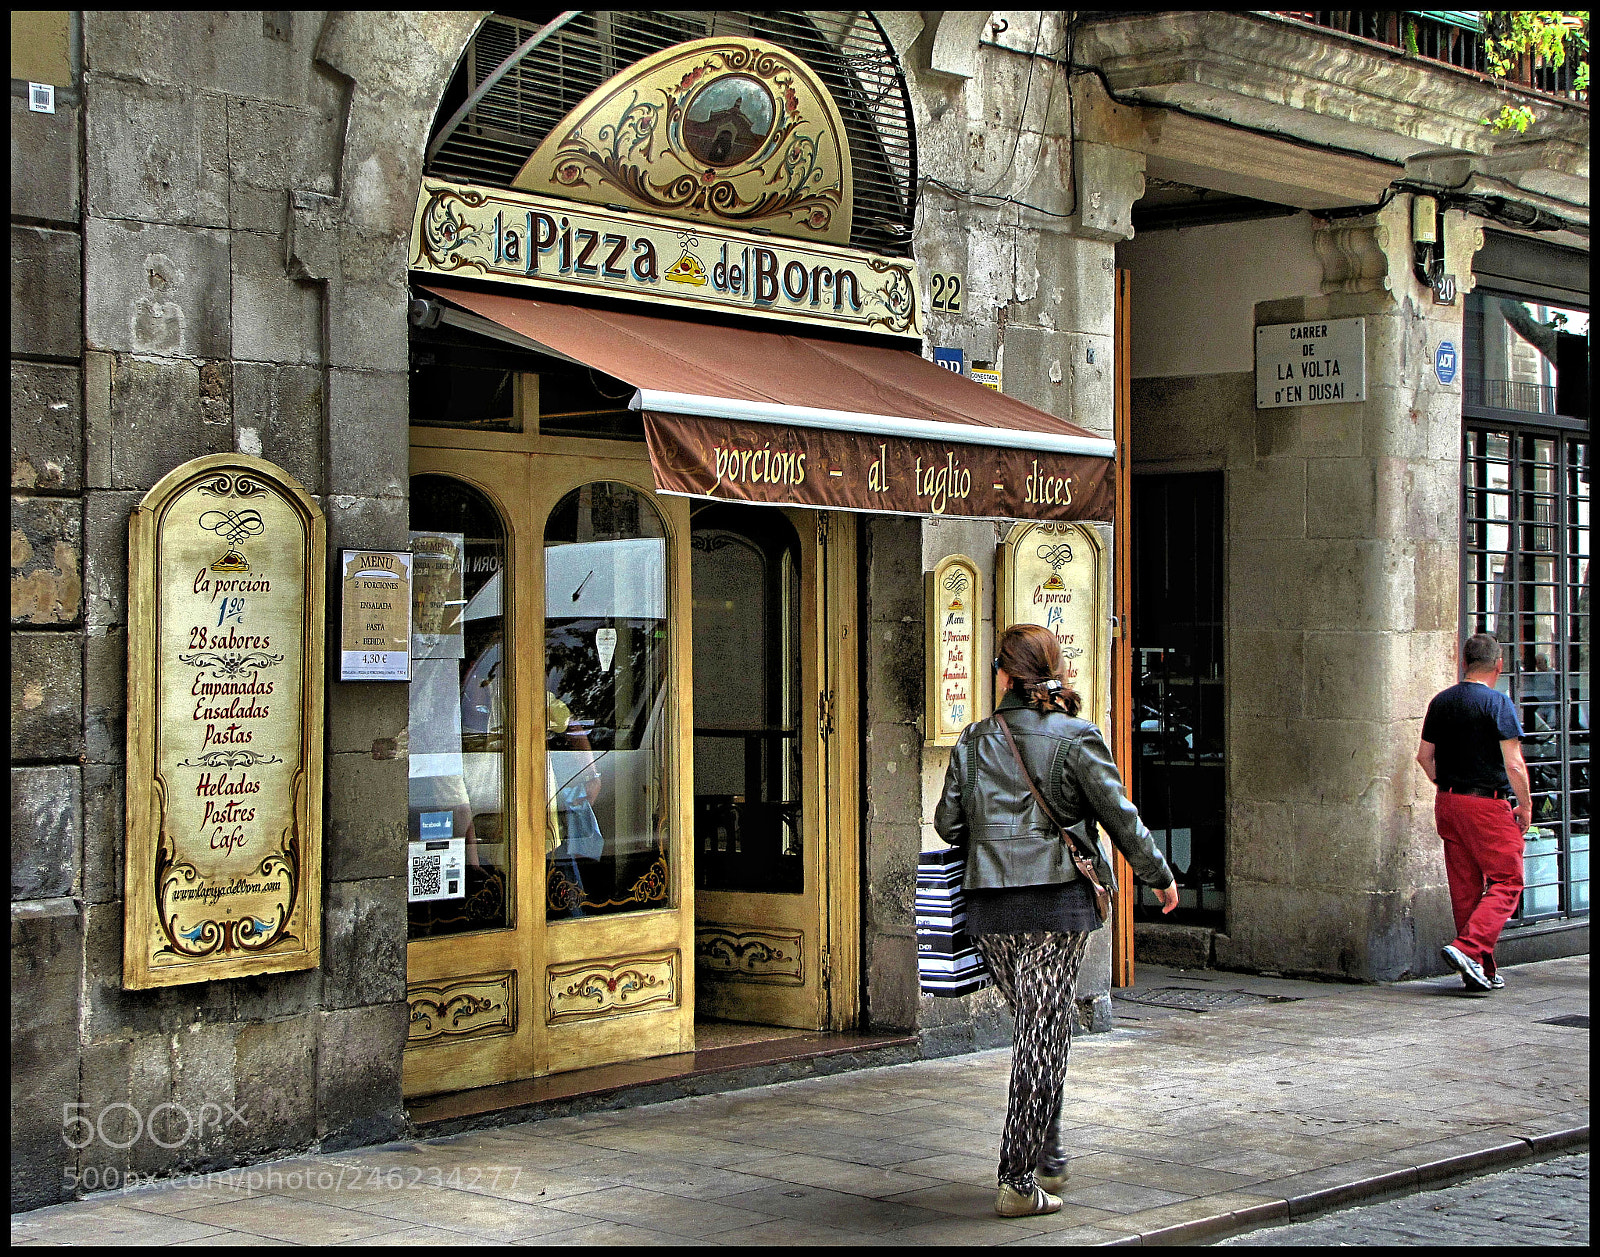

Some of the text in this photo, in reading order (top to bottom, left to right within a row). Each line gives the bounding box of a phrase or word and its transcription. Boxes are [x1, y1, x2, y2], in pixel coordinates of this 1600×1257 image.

[493, 209, 862, 313] la Pizza del Born
[932, 273, 961, 310] 22
[1438, 277, 1454, 301] 20
[1290, 325, 1328, 339] CARRER
[1302, 344, 1315, 356] DE
[1278, 360, 1340, 380] LA VOLTA
[1438, 354, 1454, 368] ADT
[1309, 383, 1344, 401] DUSAI
[706, 440, 806, 496] porcions
[868, 444, 889, 492] al
[915, 451, 971, 515] taglio
[1024, 460, 1072, 506] slices
[360, 555, 394, 569] MENU
[193, 567, 272, 604] la porción
[363, 582, 399, 590] PORCIONES
[360, 602, 392, 610] ENSALADA
[1033, 584, 1072, 610] la porció
[366, 623, 385, 631] PASTA
[188, 626, 270, 649] 28 sabores
[943, 630, 970, 646] 2 Porcions
[947, 650, 964, 665] Pasta
[943, 666, 968, 682] Amanida
[191, 670, 274, 703] Empanadas
[945, 686, 966, 706] Beguda
[193, 696, 270, 720] Ensaladas
[202, 723, 252, 752] Pastas
[196, 772, 260, 796] Helados
[200, 799, 255, 831] Postres
